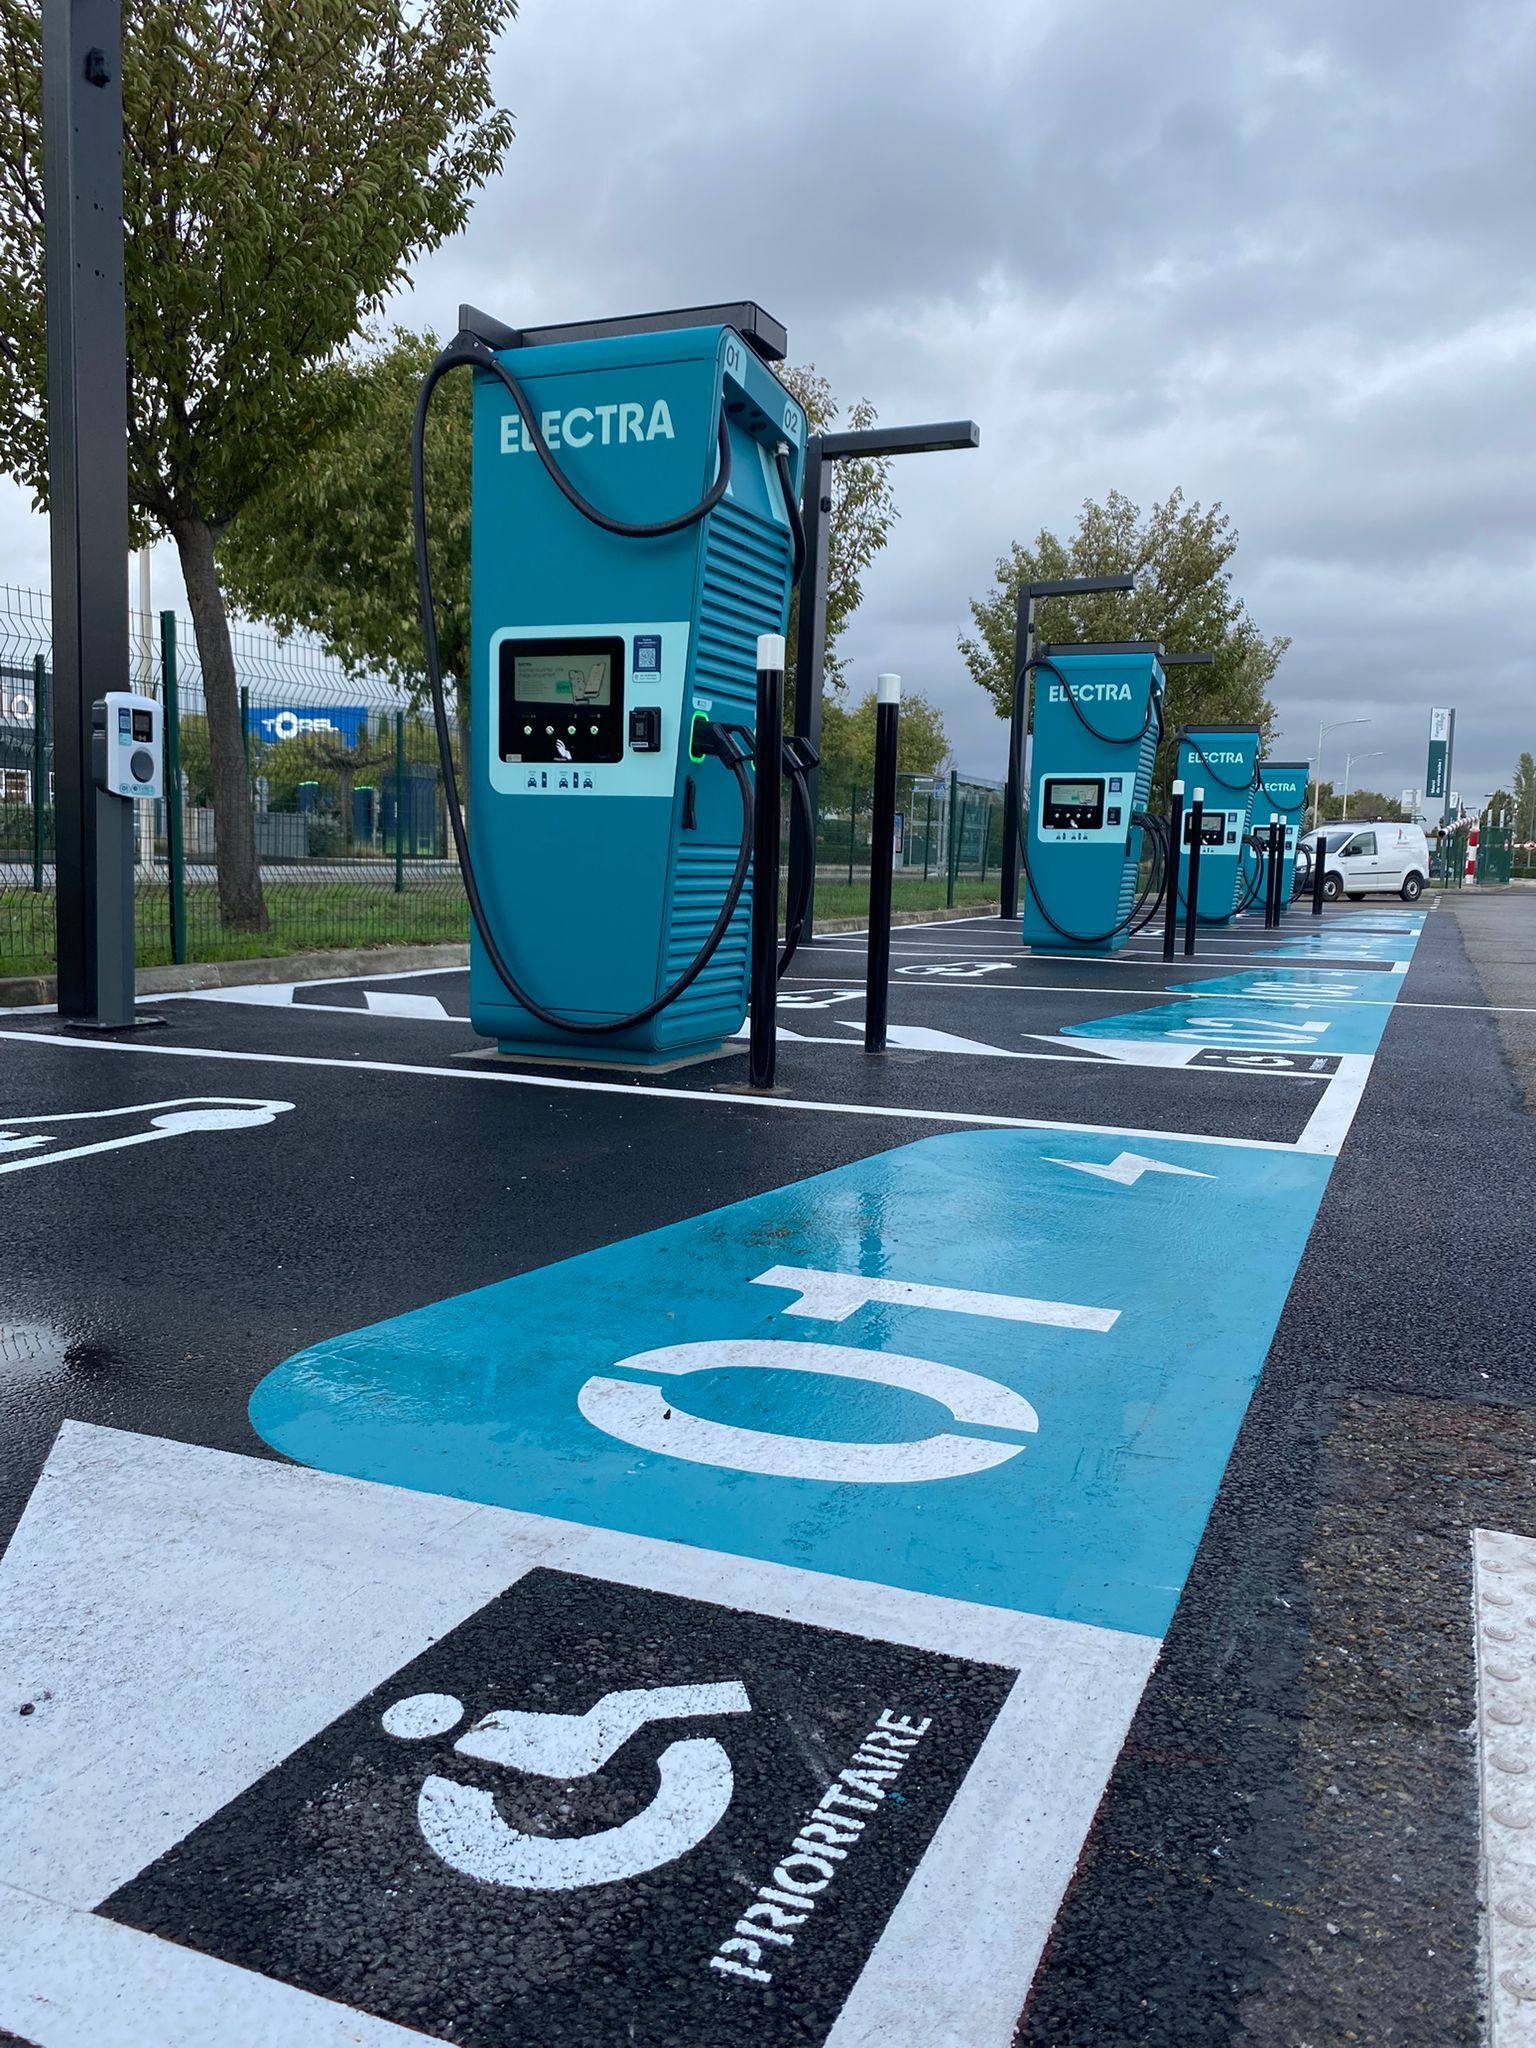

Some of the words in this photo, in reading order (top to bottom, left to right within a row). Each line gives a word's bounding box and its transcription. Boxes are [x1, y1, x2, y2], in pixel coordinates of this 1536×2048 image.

[726, 345, 741, 372] 01
[500, 399, 676, 454] ELECTRA
[784, 410, 799, 434] 02
[1049, 683, 1132, 703] ELECTRA
[1188, 751, 1244, 764] ELECTRA
[1255, 782, 1297, 792] LECTRA
[1241, 981, 1359, 997] 03
[1165, 1017, 1331, 1045] 02
[577, 1264, 1123, 1483] 01
[709, 1708, 933, 1983] PRIORITAIRE
